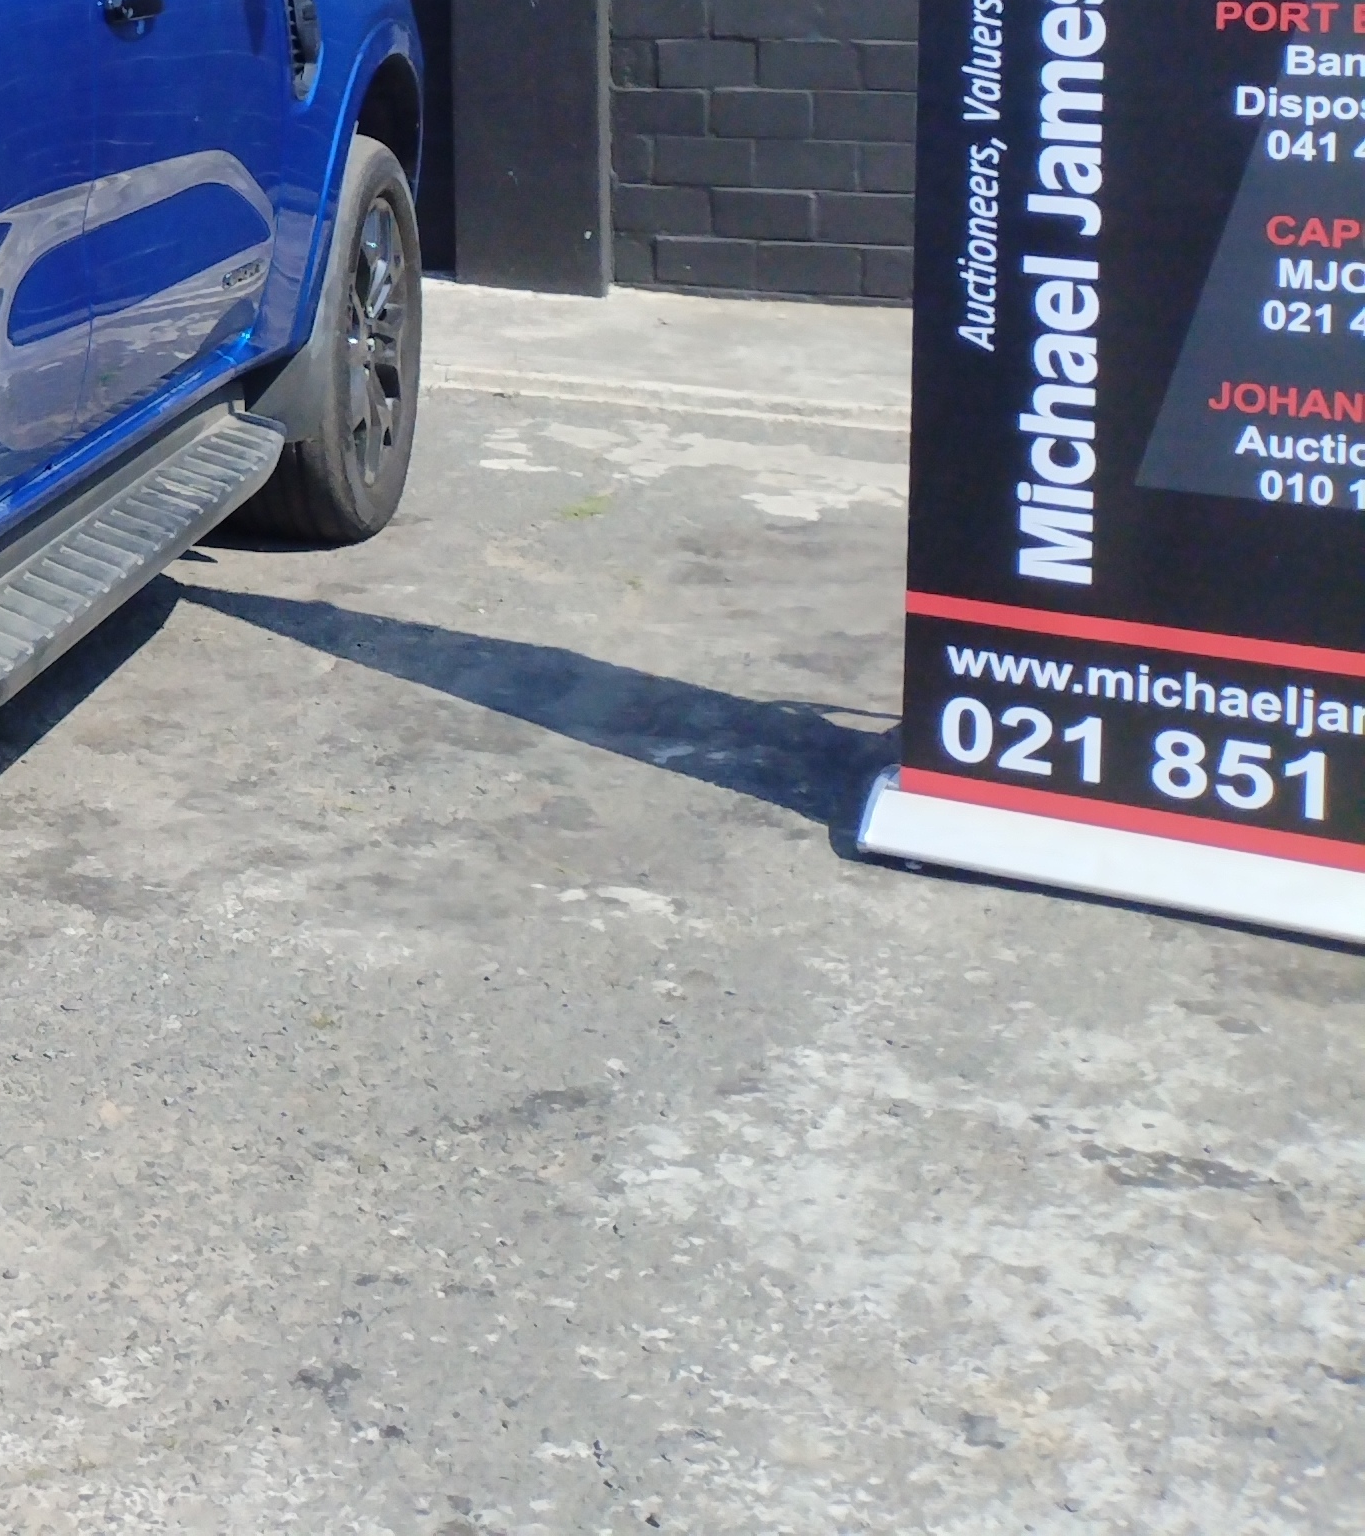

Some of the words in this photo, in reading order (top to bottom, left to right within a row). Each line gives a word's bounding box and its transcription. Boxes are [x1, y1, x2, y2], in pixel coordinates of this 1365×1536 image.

[1216, 0, 1340, 33] PORT
[1286, 44, 1365, 77] Ban
[1236, 85, 1365, 125] Dispo
[1267, 129, 1337, 162] 041
[958, 136, 1008, 352] Auctioneers,
[1263, 300, 1332, 334] 021
[1016, 255, 1101, 585] Michael
[1208, 381, 1365, 423] JOHAN
[1259, 469, 1334, 506] 010
[941, 697, 1103, 784] 021
[1152, 731, 1328, 822] 851
